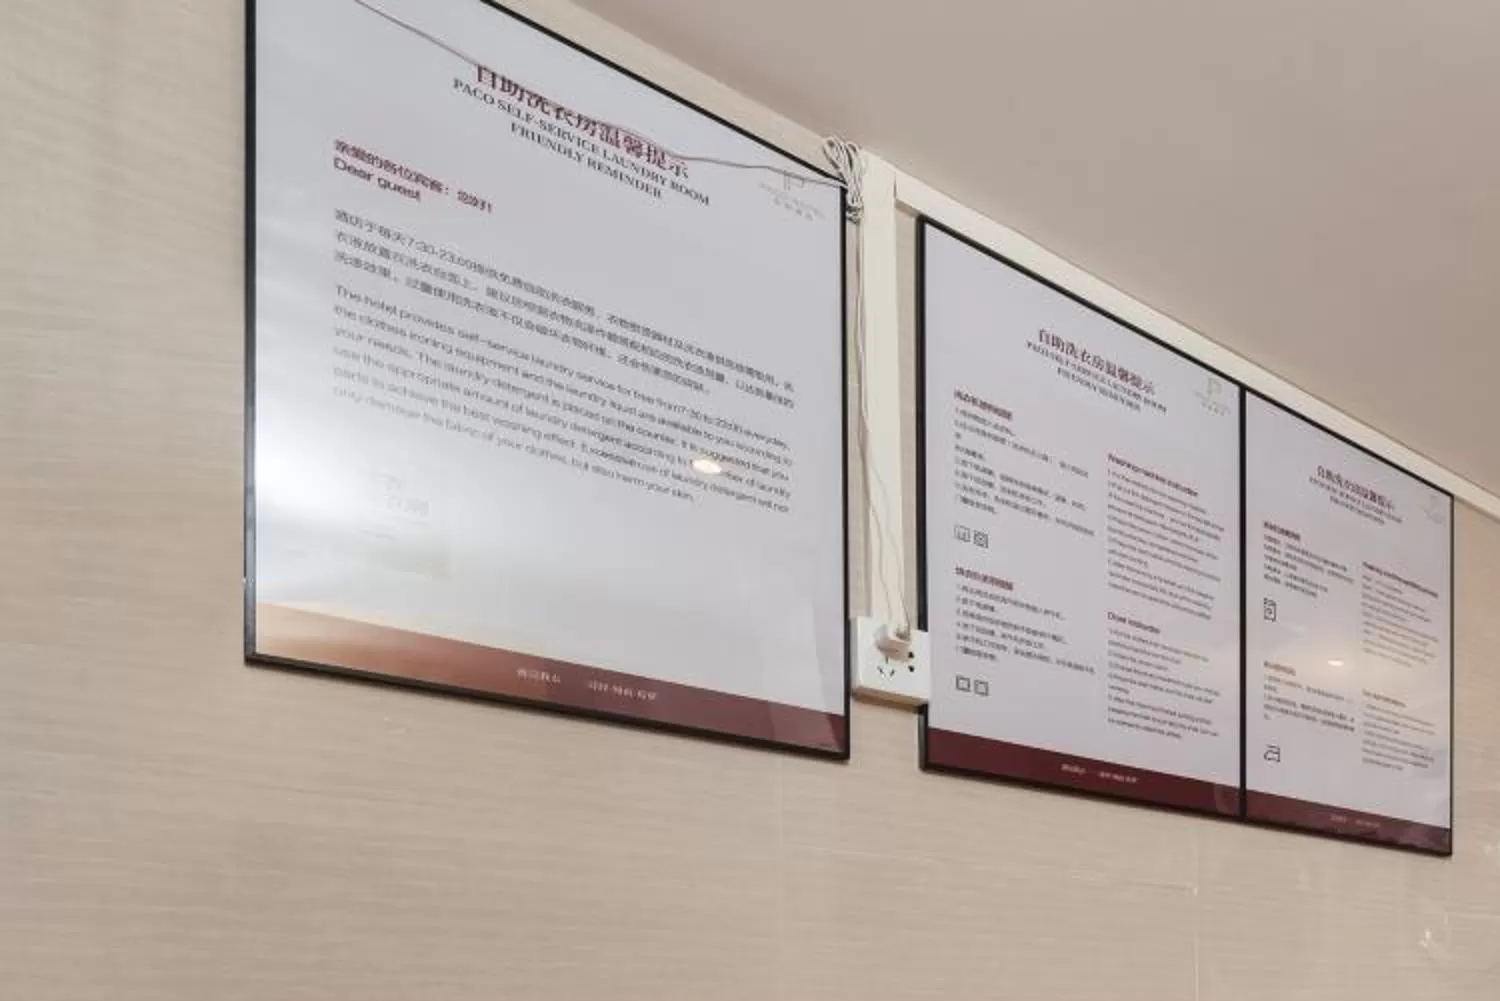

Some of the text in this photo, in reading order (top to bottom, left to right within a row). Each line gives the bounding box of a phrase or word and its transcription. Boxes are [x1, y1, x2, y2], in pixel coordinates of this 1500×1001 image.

[334, 156, 372, 183] Dear
[453, 77, 709, 207] PACO SELF-SERVICE LAUNDRY ROOM
[511, 121, 662, 200] FRIENDLY REMINDER
